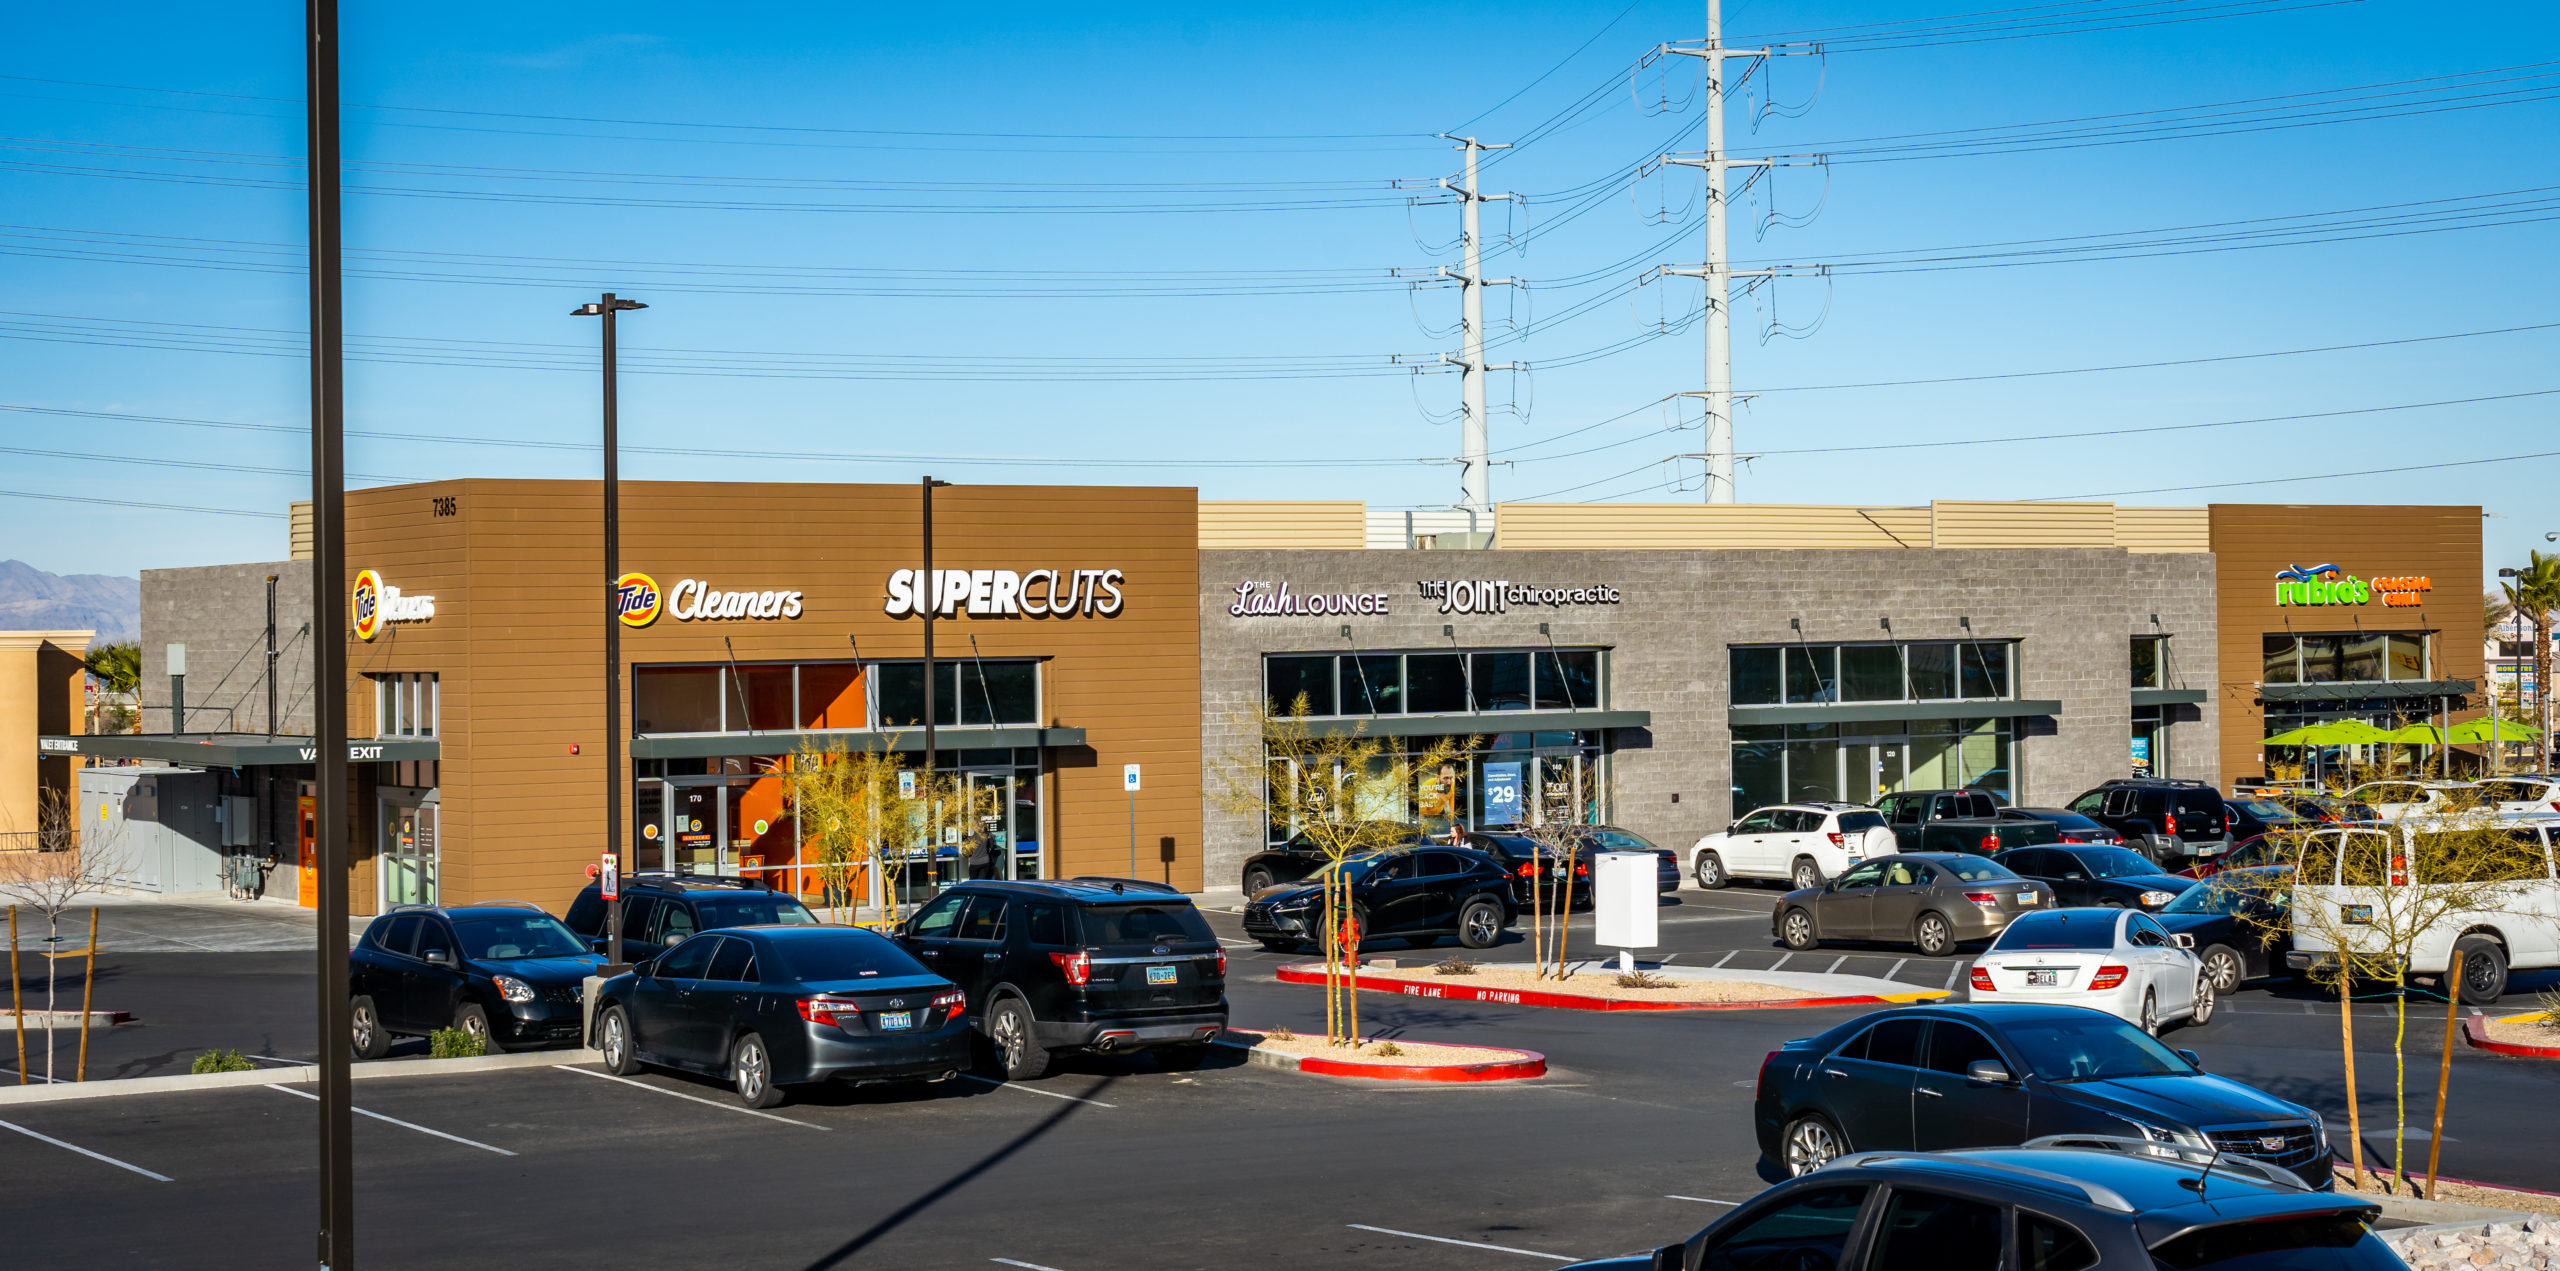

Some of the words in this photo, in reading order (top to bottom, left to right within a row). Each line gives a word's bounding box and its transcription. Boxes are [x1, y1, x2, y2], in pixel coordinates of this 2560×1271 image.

[432, 496, 457, 518] 7385
[884, 568, 1123, 614] SUPERCUTS
[1230, 580, 1294, 615] Lash
[1295, 593, 1389, 615] LOUNGE
[1254, 581, 1271, 589] THE
[1420, 580, 1445, 597] THE
[1438, 580, 1509, 613] JOINT
[1507, 584, 1620, 606] chiropractic
[2275, 571, 2370, 606] rubio's
[355, 585, 376, 629] Tide
[618, 585, 657, 616] Tide
[668, 578, 802, 620] Cleaners
[350, 746, 384, 760] EXIT
[689, 794, 702, 802] 170
[1487, 785, 1515, 804] $29
[1403, 984, 1420, 996] FIRE
[1423, 987, 1442, 998] LANE
[1476, 990, 1487, 1001] NO
[1489, 991, 1520, 1004] PARKING
